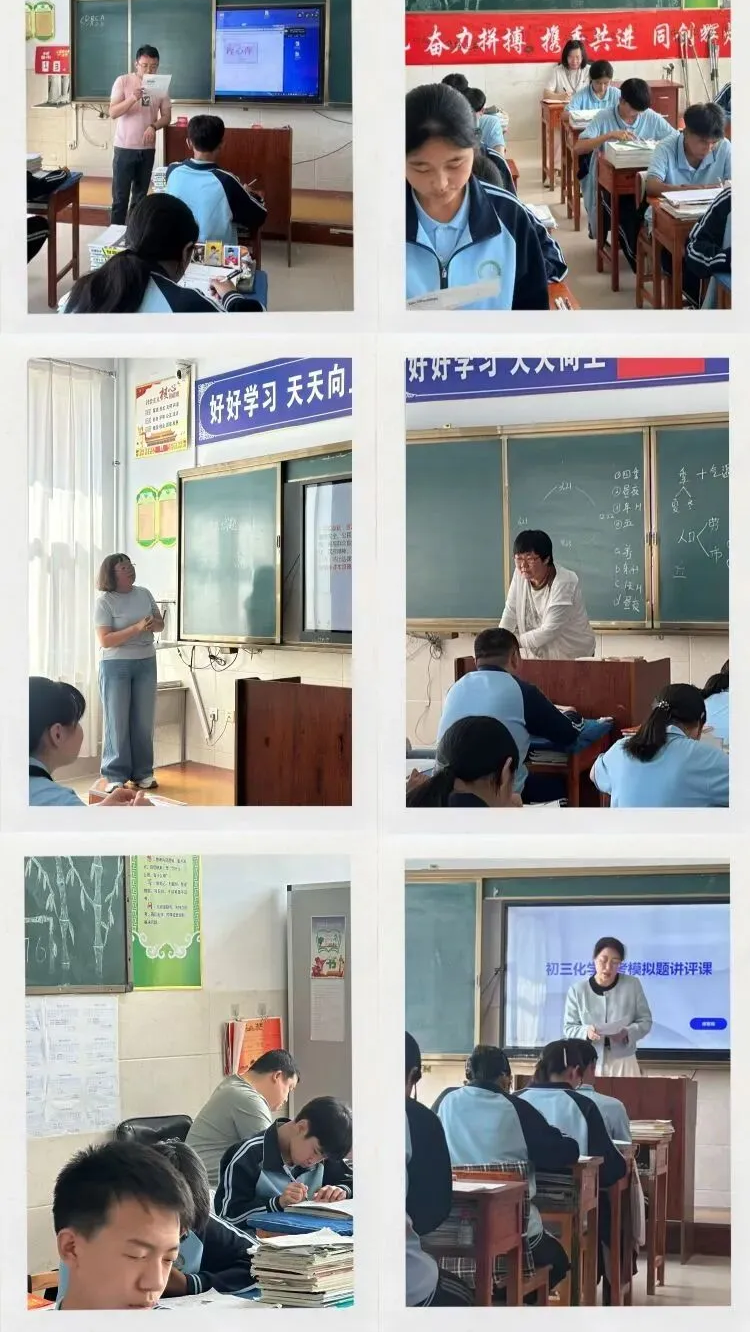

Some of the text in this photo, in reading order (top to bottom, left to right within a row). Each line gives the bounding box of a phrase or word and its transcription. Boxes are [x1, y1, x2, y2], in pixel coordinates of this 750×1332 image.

[424, 24, 527, 57] 奋力拼搏
[210, 363, 352, 425] 好好学习 天天向
[546, 961, 713, 976] 初三化学考模拟题讲评课
